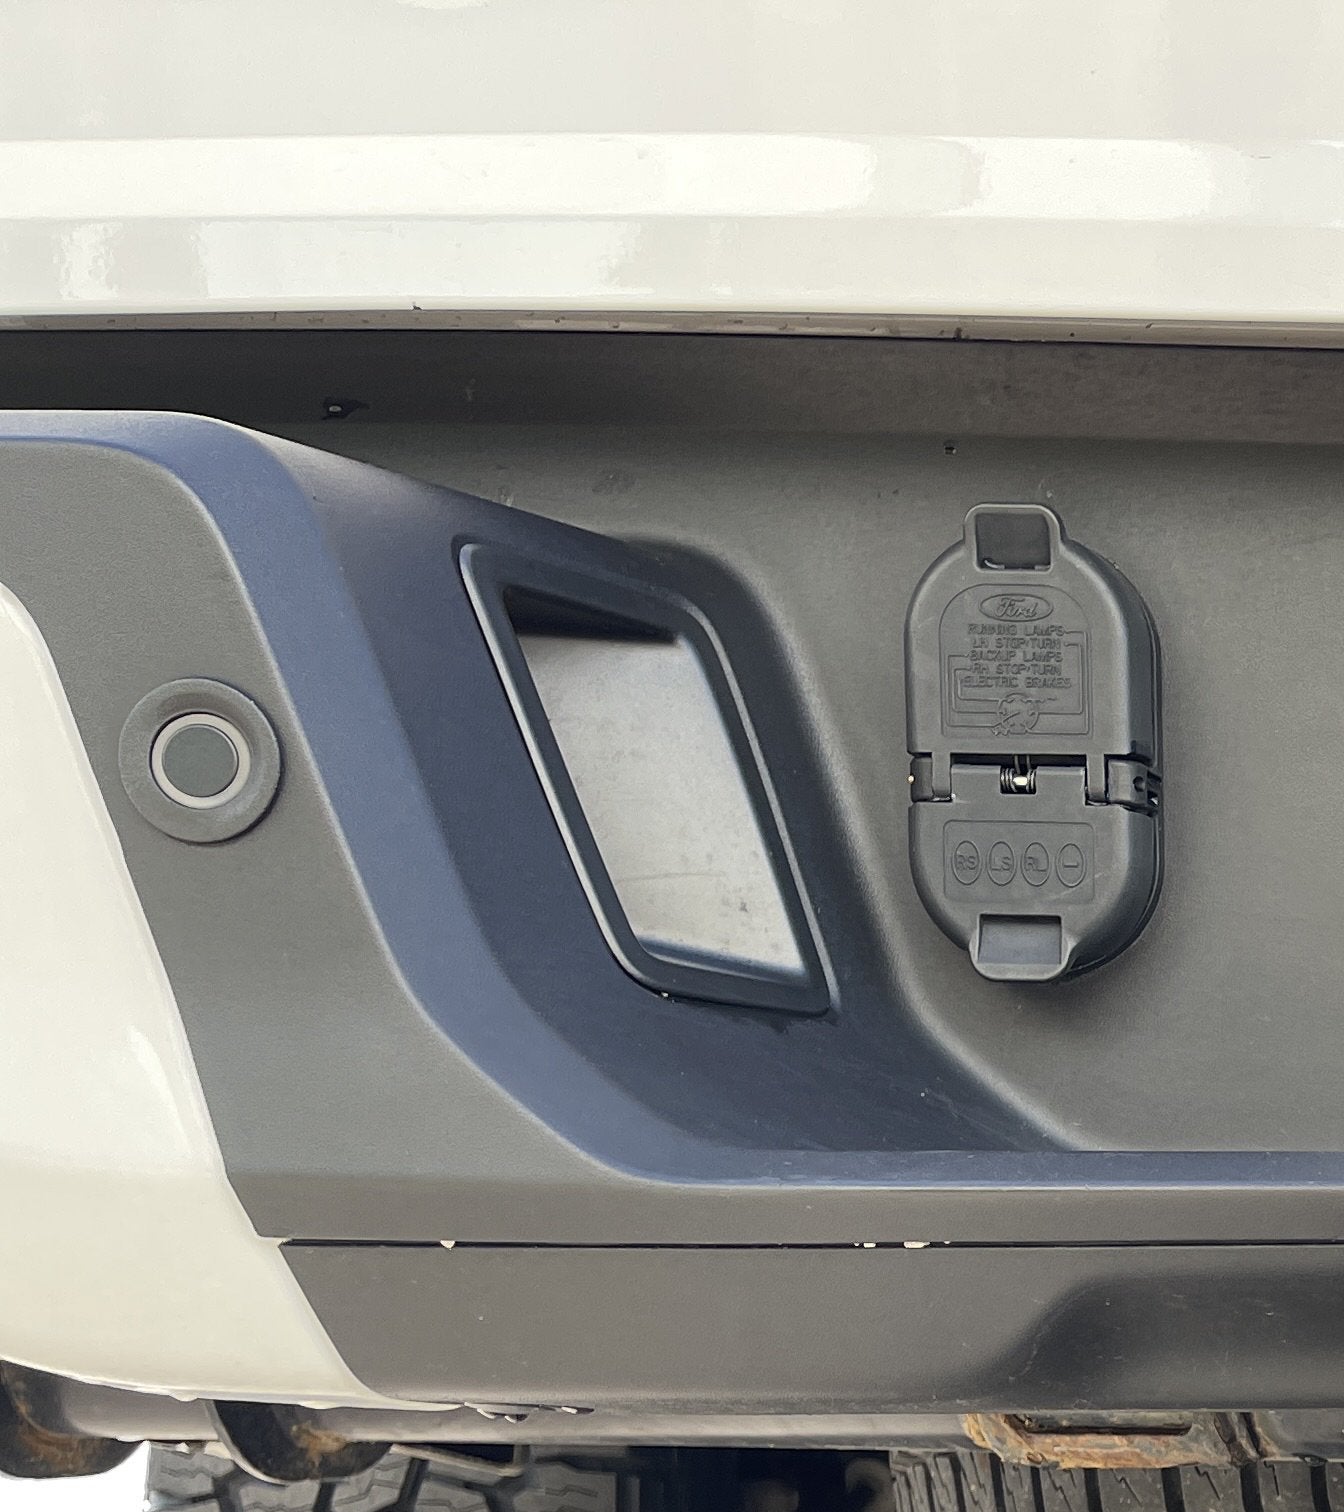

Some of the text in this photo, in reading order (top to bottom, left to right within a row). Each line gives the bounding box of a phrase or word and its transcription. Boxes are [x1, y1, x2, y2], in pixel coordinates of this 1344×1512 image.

[995, 598, 1039, 618] Ford
[1024, 625, 1065, 636] LAMPS
[970, 650, 1063, 662] BACKUP LAMPS
[964, 676, 1072, 688] ELECTRIC BRAKES
[955, 854, 977, 870] RS
[990, 856, 1013, 871] LS
[1024, 856, 1048, 871] RL
